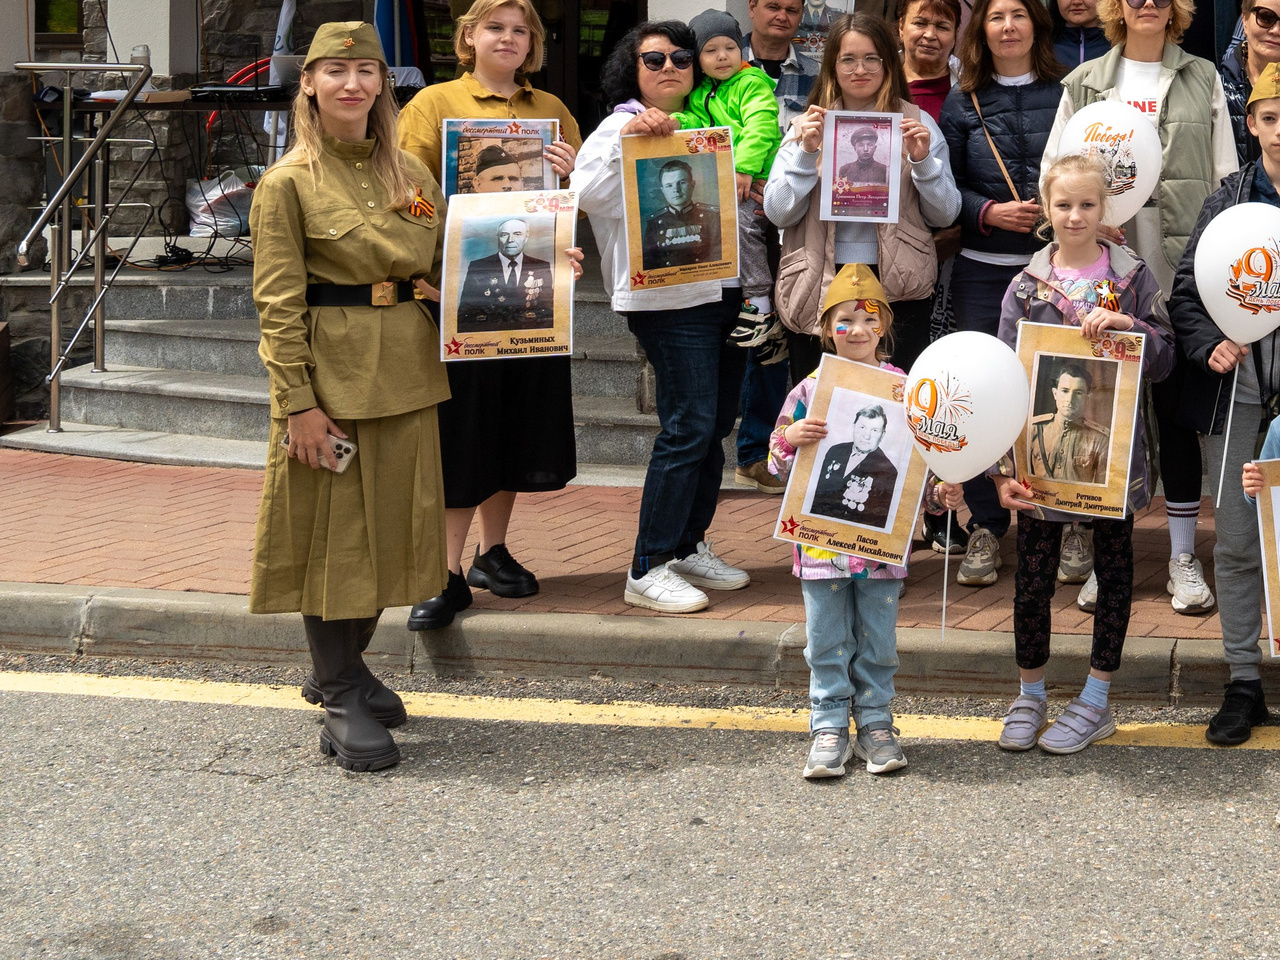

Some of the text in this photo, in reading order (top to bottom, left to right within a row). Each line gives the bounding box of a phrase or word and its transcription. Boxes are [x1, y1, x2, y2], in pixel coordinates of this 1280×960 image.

[1084, 122, 1134, 148] Победа!
[707, 136, 718, 152] 9
[548, 197, 560, 212] 9
[1242, 247, 1274, 290] 9
[510, 336, 555, 346] Кузьминых
[496, 344, 569, 356] Михаил Иванович
[1114, 341, 1126, 360] 9
[913, 378, 938, 421] 9
[1055, 498, 1124, 512] Дмитрий Дмитриевич
[856, 534, 878, 546] Пасов
[826, 538, 903, 561] Алексей Михайлович
